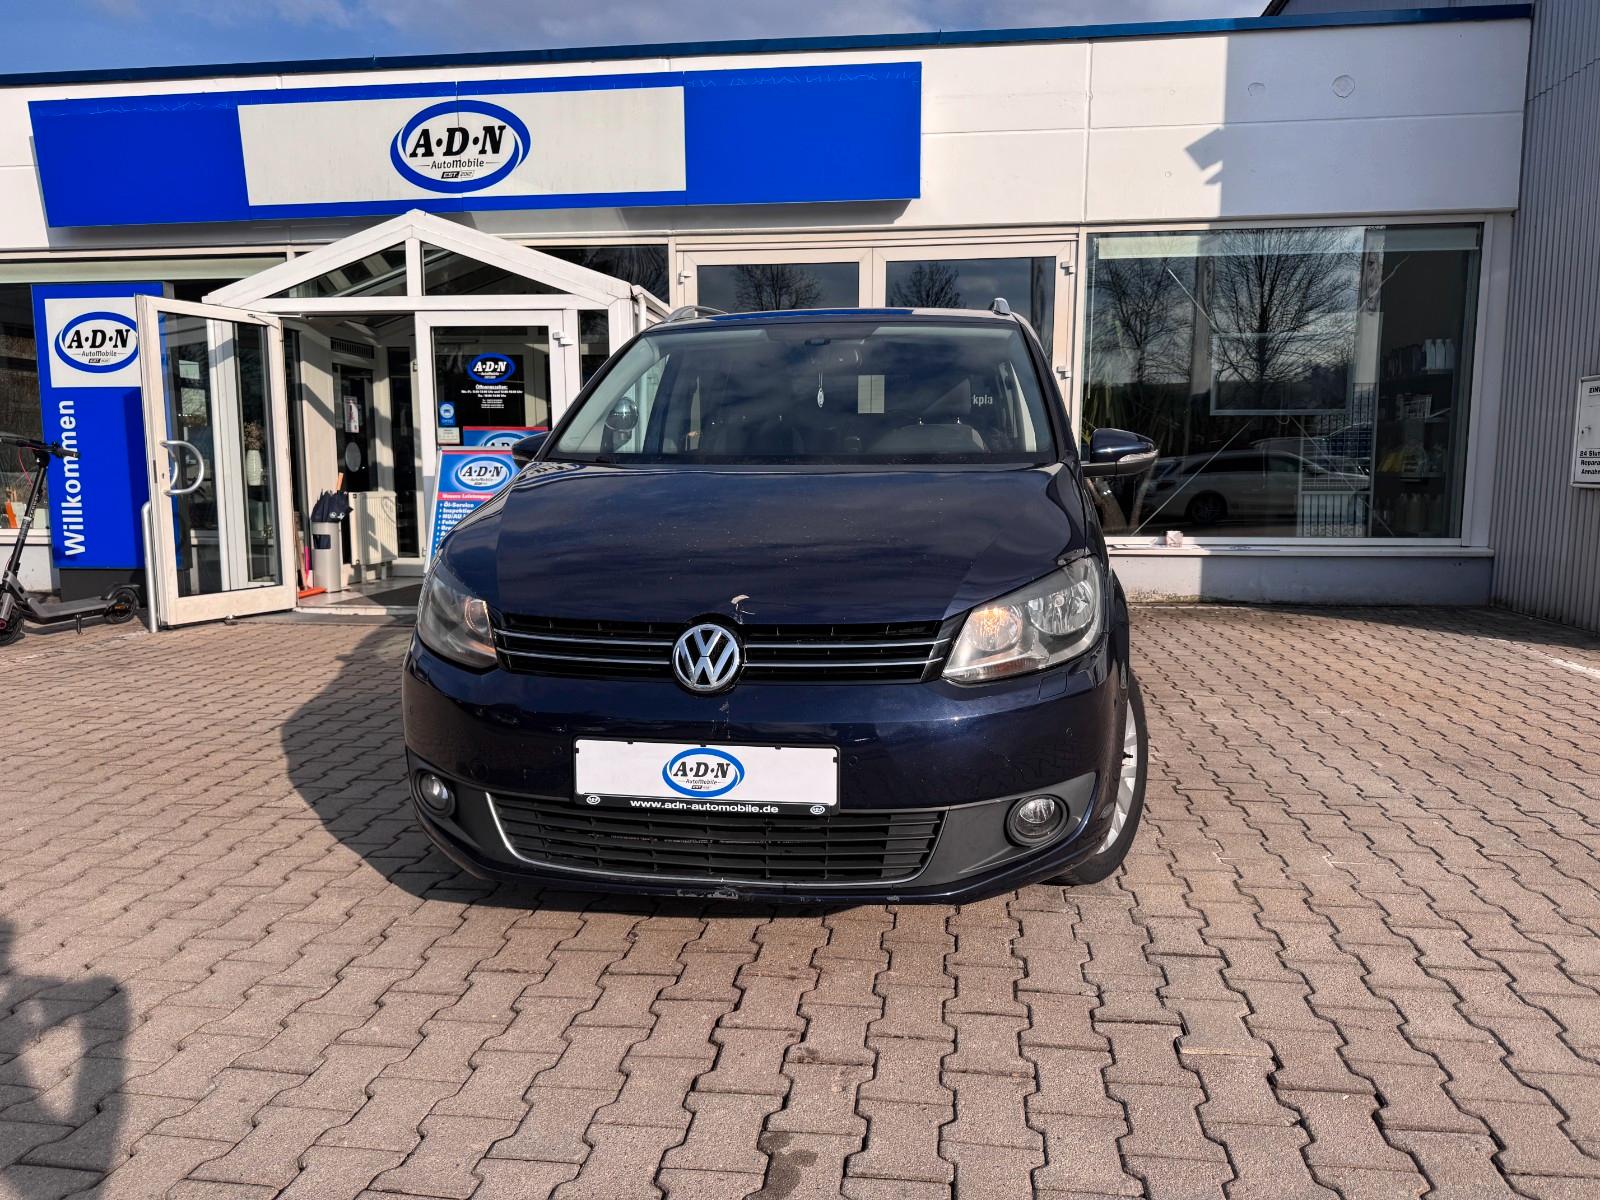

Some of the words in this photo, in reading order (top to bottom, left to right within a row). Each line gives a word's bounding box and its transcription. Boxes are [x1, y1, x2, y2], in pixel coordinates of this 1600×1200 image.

[431, 158, 484, 169] AutoMobile
[58, 400, 86, 556] Willkommen
[630, 800, 779, 813] www.adn-automobile.de
